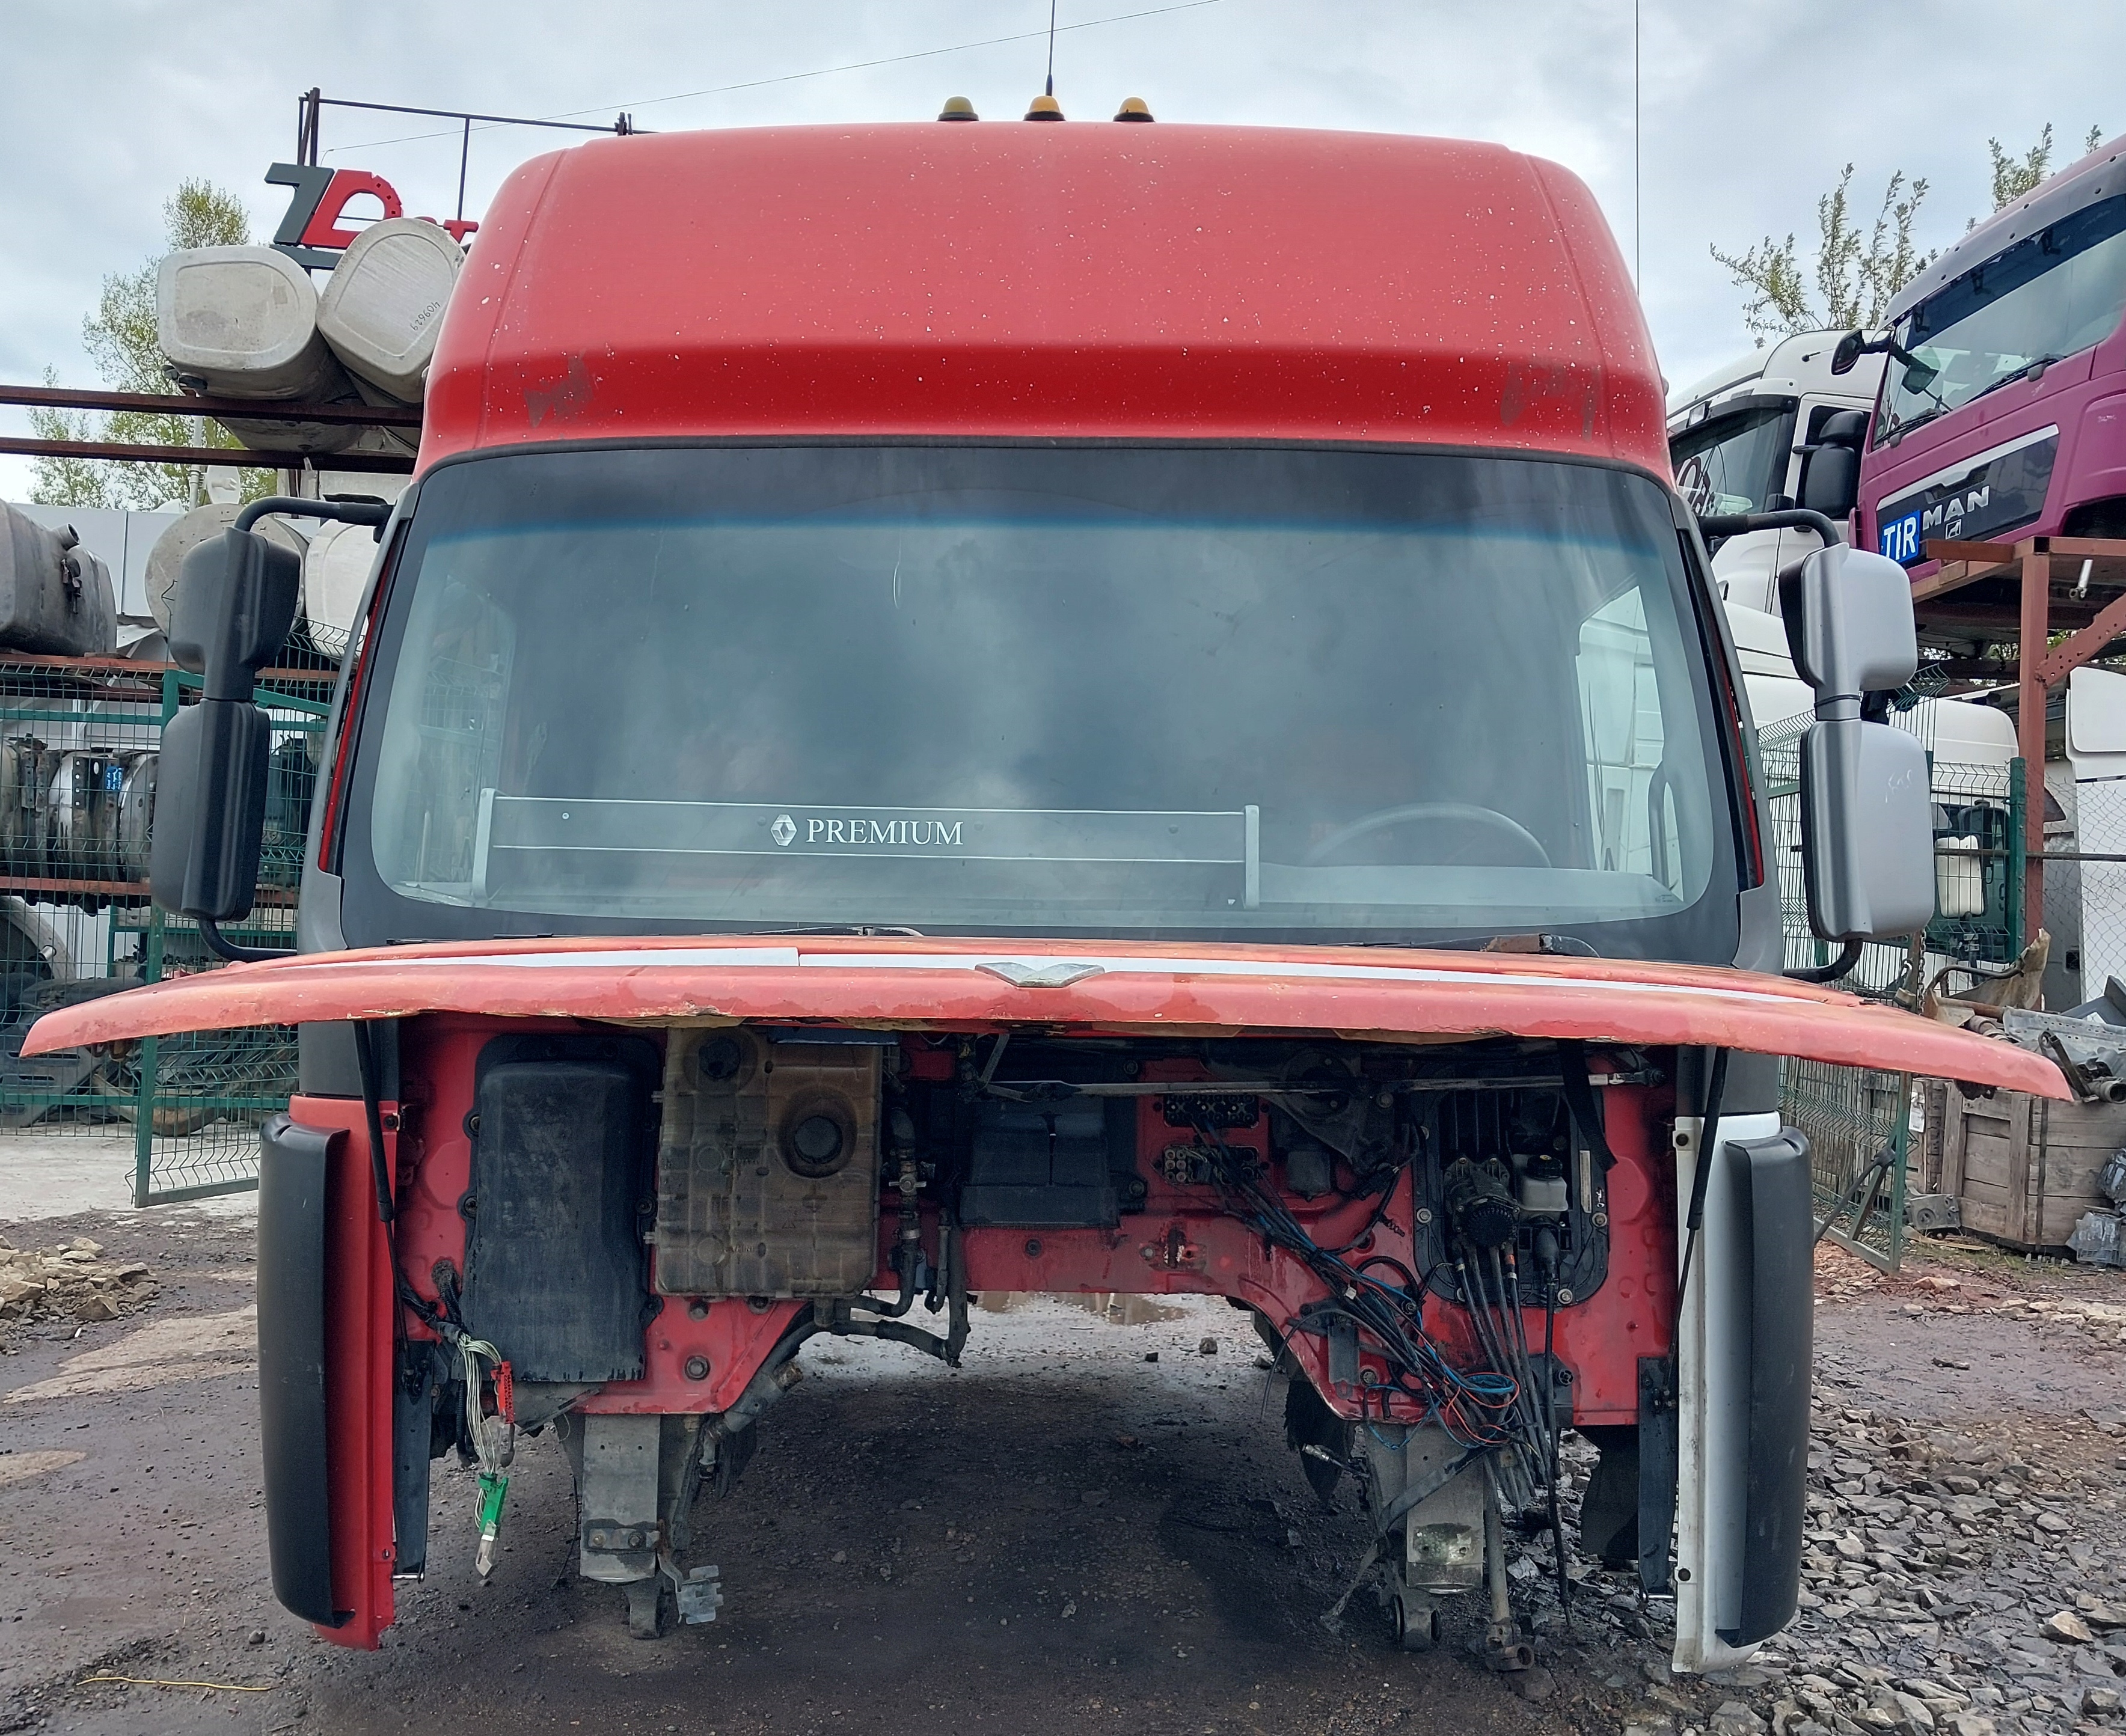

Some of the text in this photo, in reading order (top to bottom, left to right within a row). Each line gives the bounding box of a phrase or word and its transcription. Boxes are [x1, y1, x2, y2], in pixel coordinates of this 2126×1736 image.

[410, 302, 441, 331] 409629
[1923, 486, 1990, 531] MAN
[1883, 516, 1916, 561] TIR
[806, 818, 963, 846] PREMIUM
